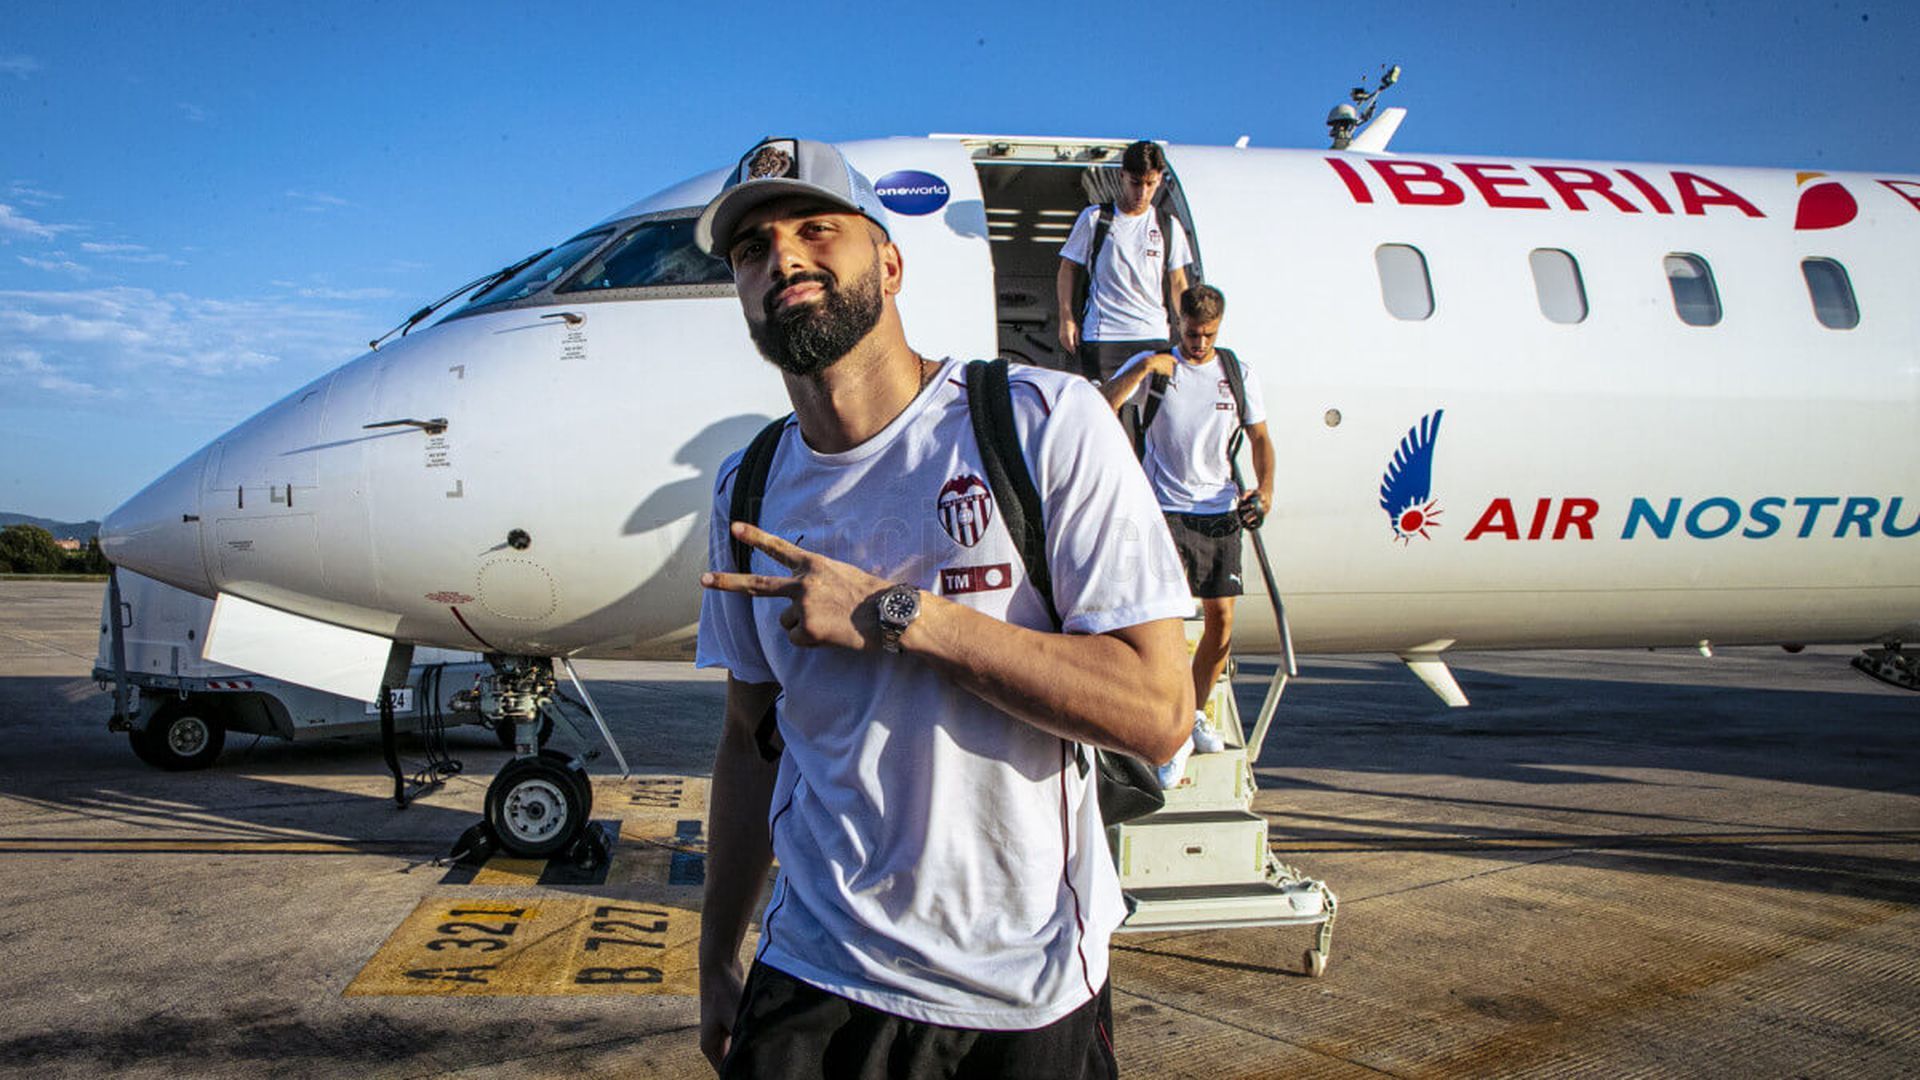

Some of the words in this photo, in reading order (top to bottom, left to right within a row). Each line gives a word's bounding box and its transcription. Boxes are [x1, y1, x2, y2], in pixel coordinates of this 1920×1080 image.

[876, 185, 948, 196] oneworld
[1323, 157, 1768, 219] IBERIA
[1463, 497, 1600, 541] AIR
[1620, 496, 1920, 540] NOSTRU
[945, 573, 970, 590] TM
[426, 907, 529, 954] 321
[584, 905, 670, 951] 727
[401, 964, 498, 985] A
[573, 964, 665, 986] B
